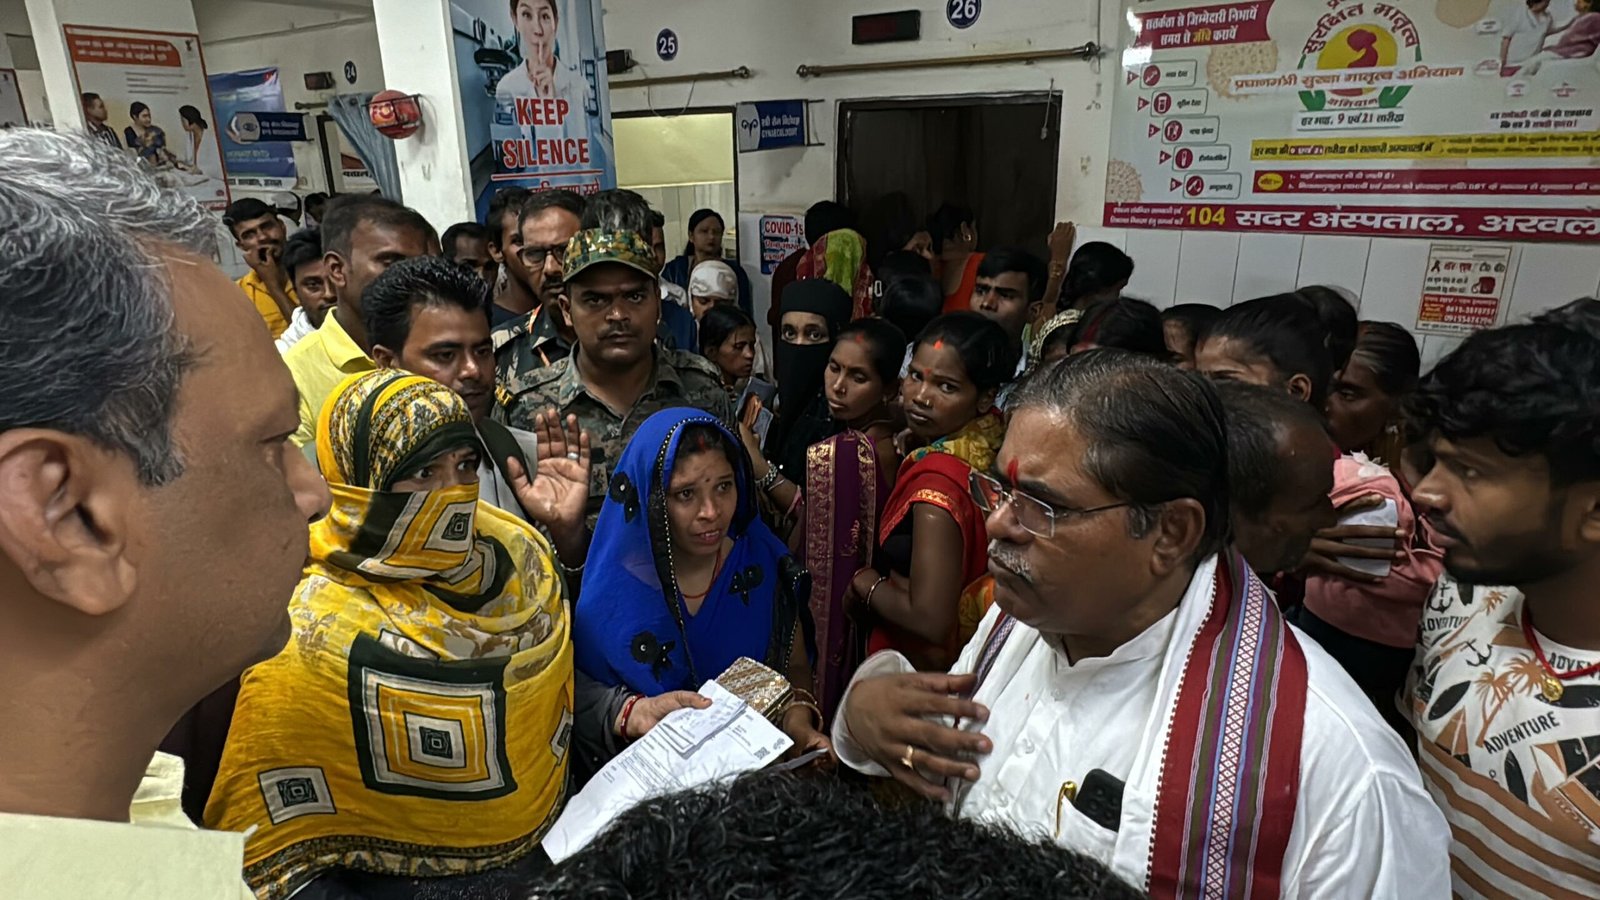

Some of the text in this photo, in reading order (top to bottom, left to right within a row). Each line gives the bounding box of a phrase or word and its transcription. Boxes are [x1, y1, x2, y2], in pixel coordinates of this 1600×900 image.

[951, 0, 976, 19] 26
[1146, 14, 1175, 30] सतर्कता
[1177, 12, 1185, 27] से
[1187, 9, 1226, 26] जिम्मेदारी
[659, 37, 675, 54] 25
[1161, 33, 1181, 45] समय
[1183, 30, 1191, 44] से
[346, 65, 356, 79] 24
[1397, 65, 1464, 80] अभियान
[516, 98, 569, 126] KEEP
[1301, 117, 1313, 126] हर
[1338, 113, 1345, 124] 9
[1362, 113, 1374, 123] 21
[503, 138, 590, 168] SILENCE
[1186, 206, 1226, 226] 104
[1235, 211, 1305, 227] सदर
[1483, 711, 1561, 754] ADVENTURE
